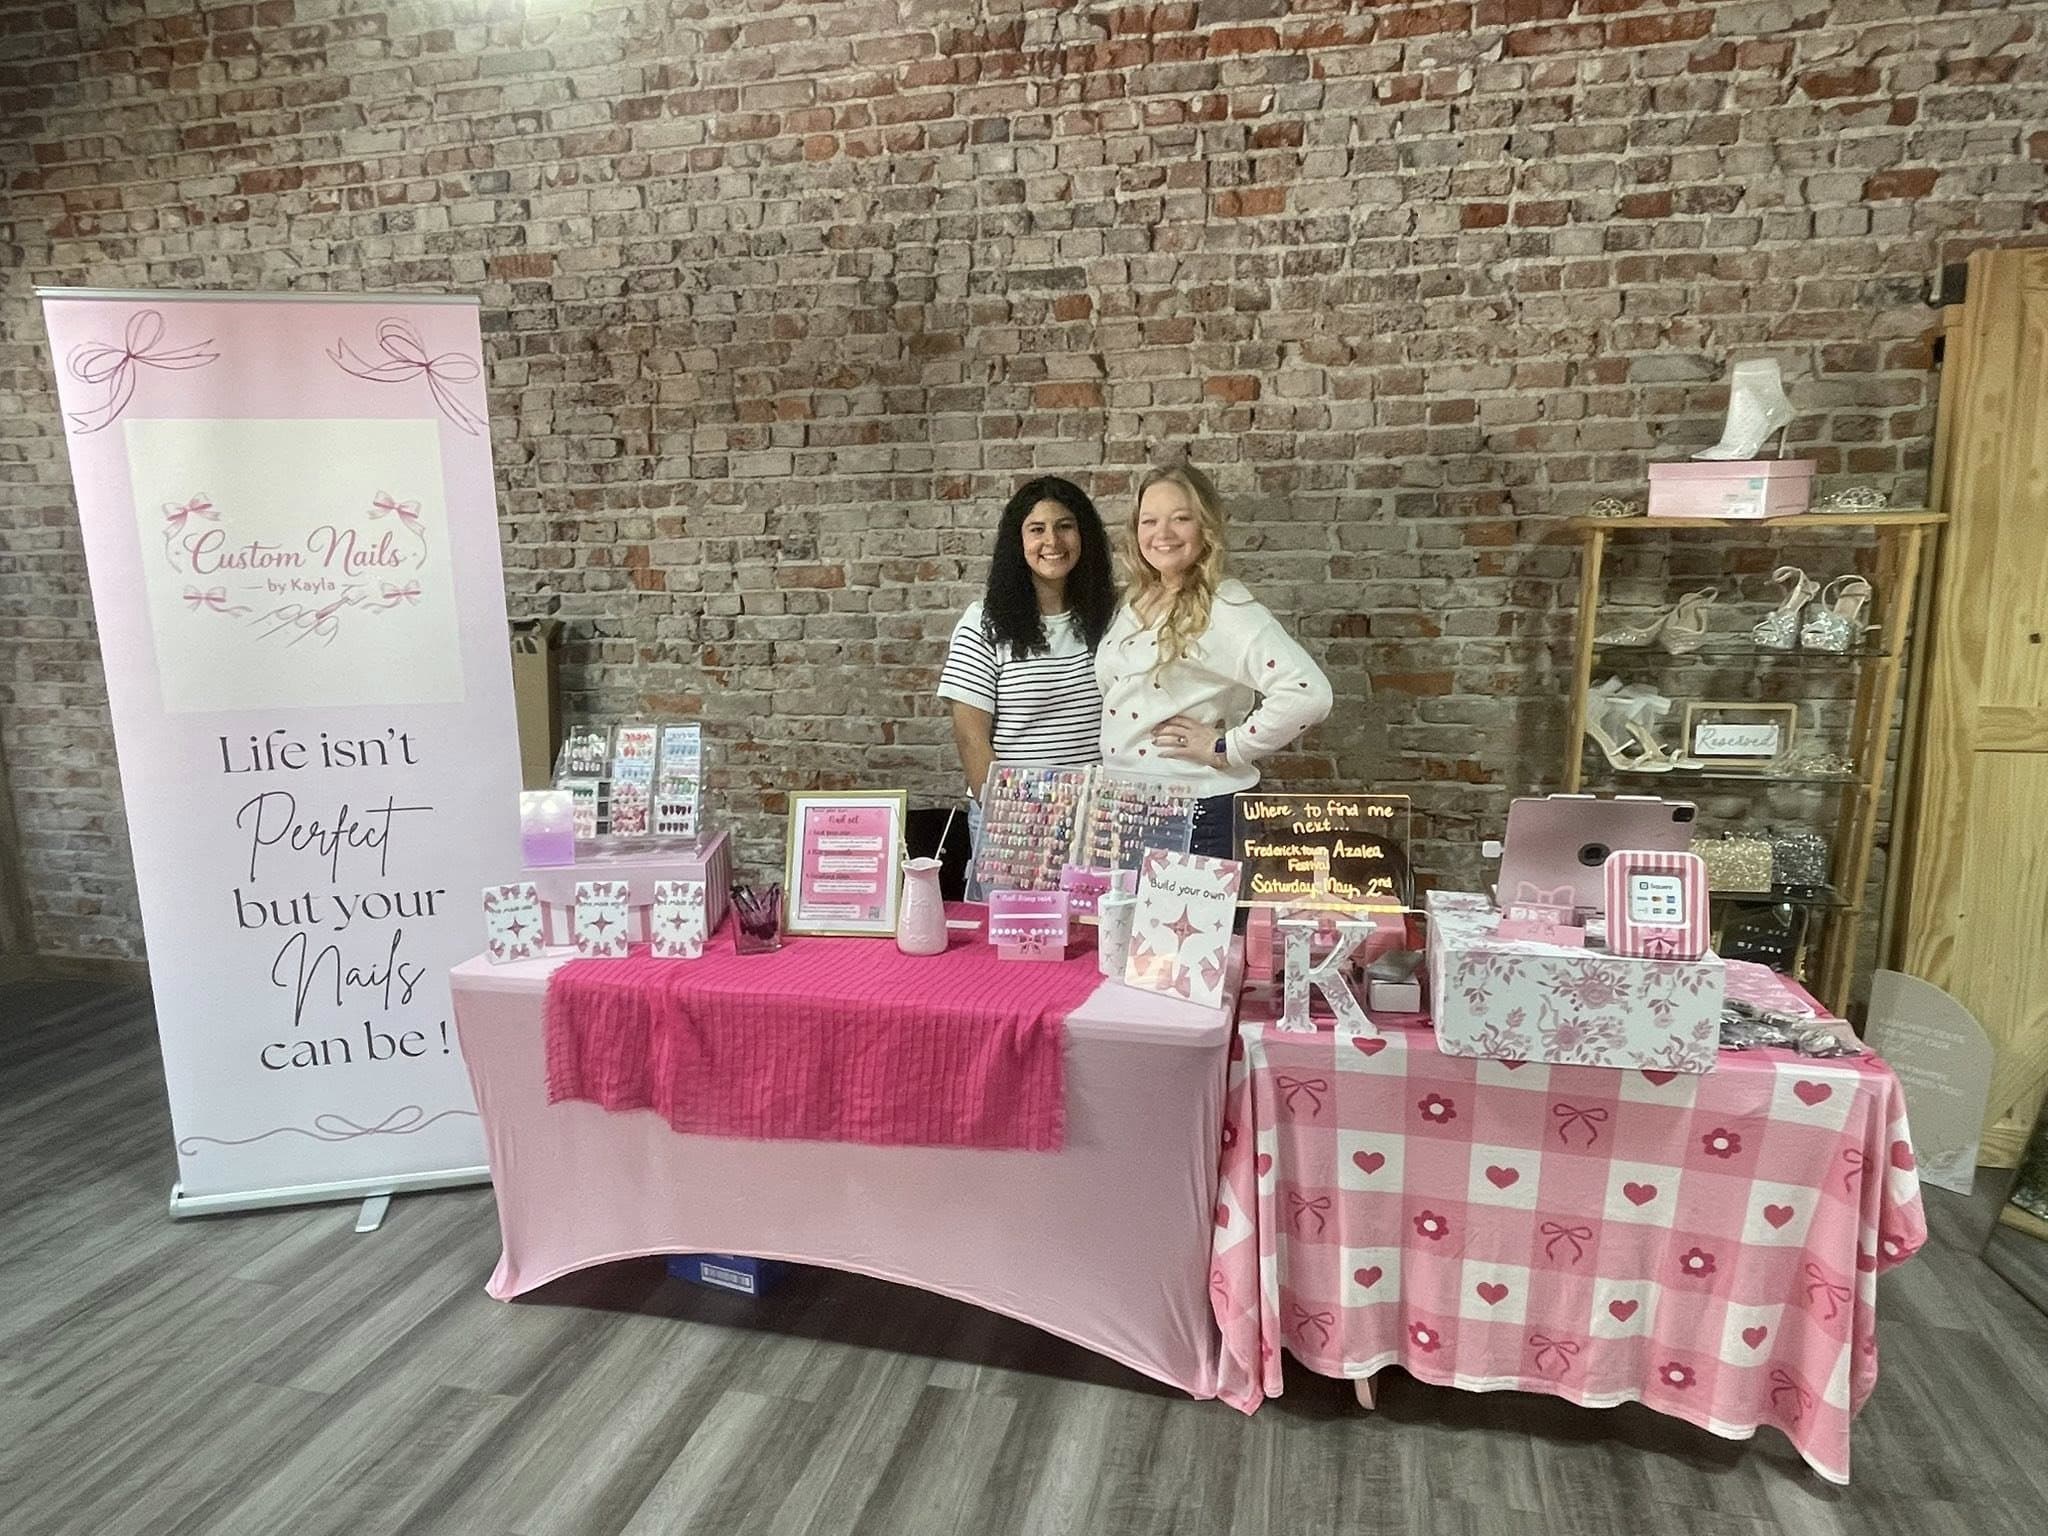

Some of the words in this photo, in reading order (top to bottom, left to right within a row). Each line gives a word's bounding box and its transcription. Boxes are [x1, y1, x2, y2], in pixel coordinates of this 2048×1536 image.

[183, 529, 305, 575] Custom
[307, 525, 404, 575] Nails
[267, 578, 287, 593] by
[291, 577, 336, 594] Kayla
[220, 729, 308, 774] Life
[1698, 727, 1776, 750] Reserved
[1304, 803, 1321, 818] to
[1327, 799, 1359, 817] find
[1367, 805, 1394, 818] me
[236, 791, 434, 883] Perfect
[1333, 839, 1384, 858] Azalea
[1150, 878, 1177, 892] Build
[1177, 884, 1201, 897] your
[1203, 889, 1225, 901] own
[233, 887, 325, 929] but
[333, 888, 446, 932] your
[271, 929, 426, 1026] Nails
[1276, 919, 1379, 1035] K
[261, 1038, 353, 1071] can
